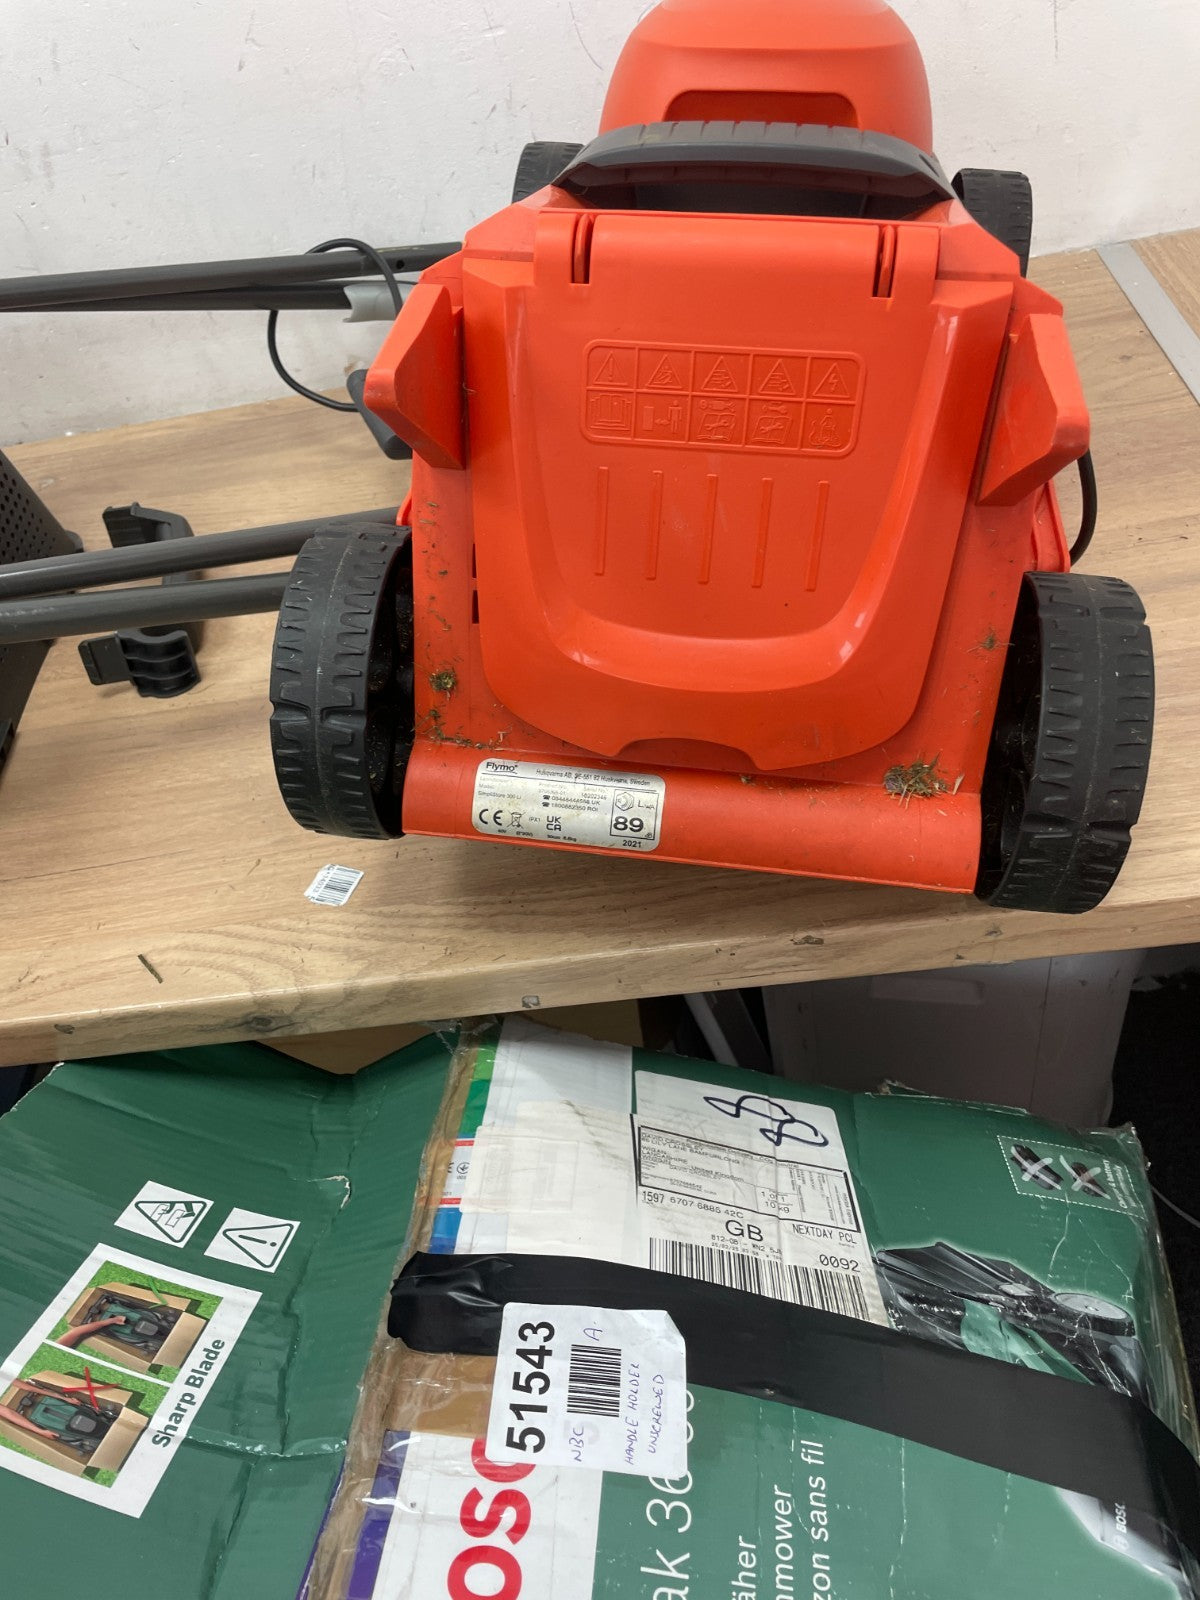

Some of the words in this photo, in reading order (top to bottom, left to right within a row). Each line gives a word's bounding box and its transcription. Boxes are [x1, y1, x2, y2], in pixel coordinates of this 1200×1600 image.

[486, 762, 516, 772] Flymo
[629, 778, 651, 786] Sweden
[613, 815, 644, 833] 89
[622, 839, 642, 848] 2021
[642, 1190, 665, 1204] 1597
[723, 1208, 744, 1219] 42C
[725, 1219, 764, 1242] GB
[792, 1223, 833, 1240] NEXTDAY
[839, 1231, 858, 1245] PCL
[819, 1253, 861, 1273] 0092
[151, 1392, 197, 1448] Sharp
[184, 1339, 226, 1389] Blade
[505, 1321, 555, 1454] 51543
[627, 1362, 641, 1411] HOLDER
[647, 1373, 665, 1454] UNSCREWED
[624, 1416, 641, 1465] HANDLE
[800, 1439, 825, 1465] fil
[808, 1475, 830, 1543] sans
[773, 1484, 794, 1600] mower
